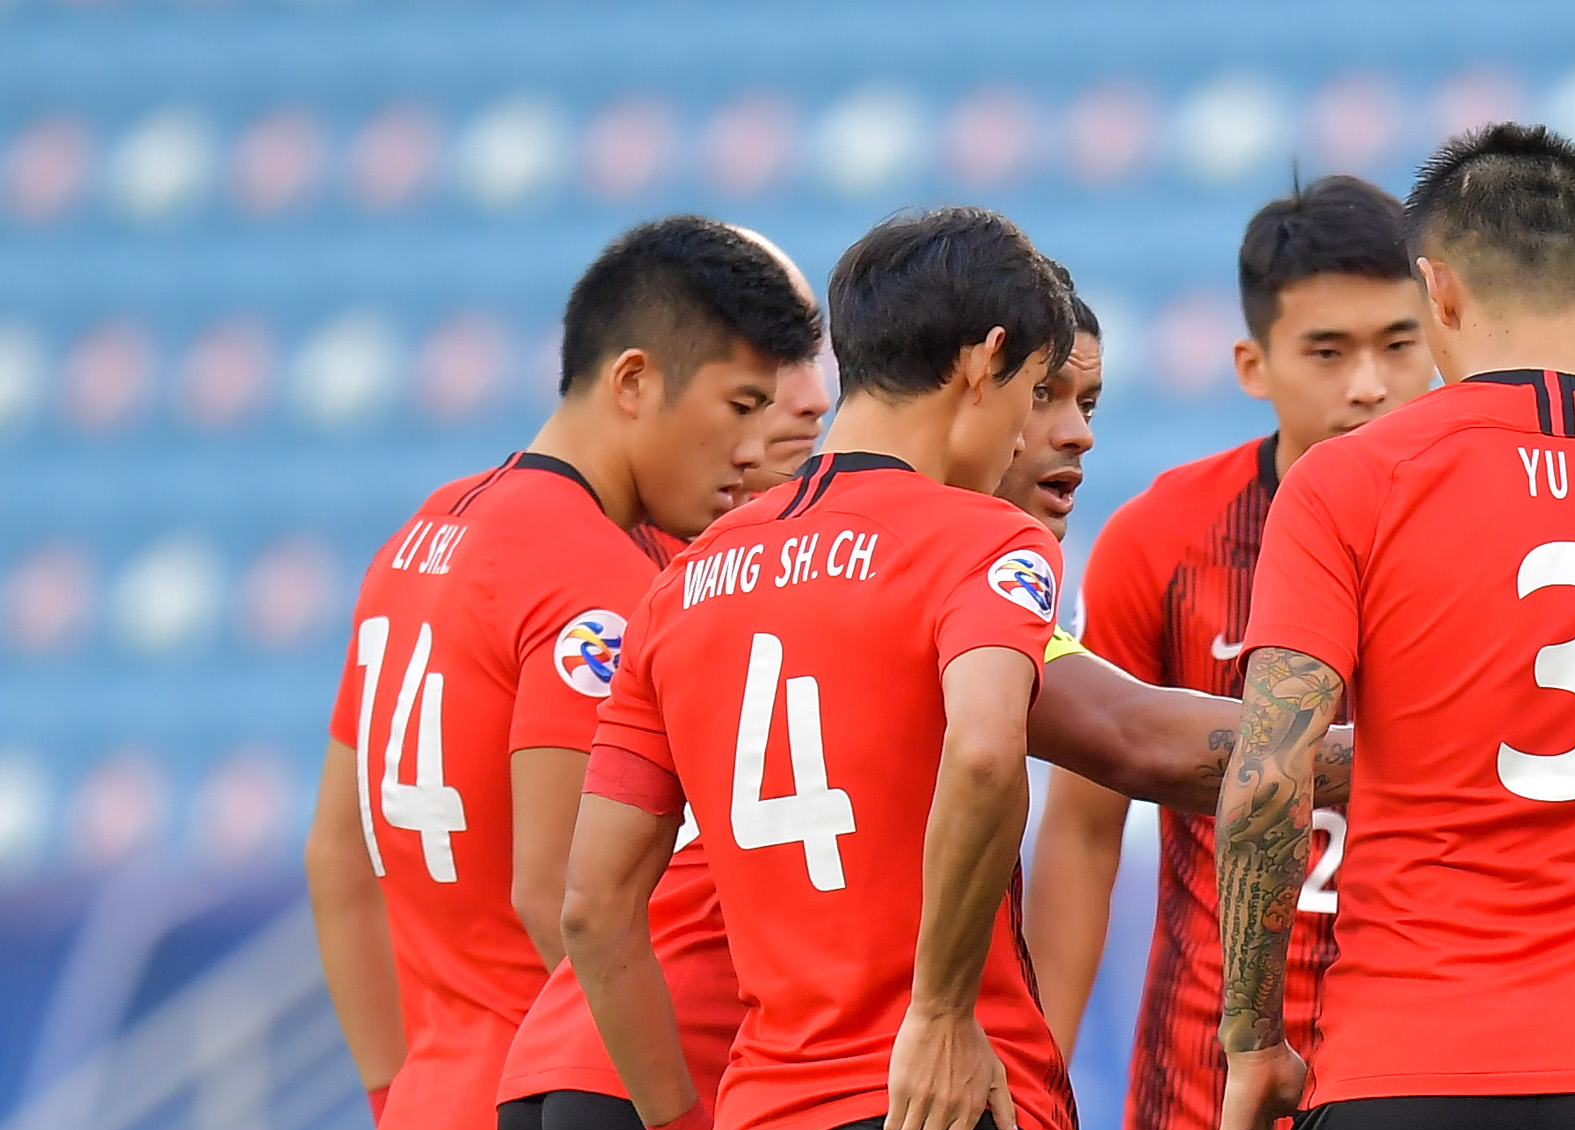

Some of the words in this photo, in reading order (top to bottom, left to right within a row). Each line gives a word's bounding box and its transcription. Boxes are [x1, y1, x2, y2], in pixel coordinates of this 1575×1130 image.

[1517, 446, 1569, 500] YU
[391, 519, 434, 571] LI
[682, 542, 765, 610] WANG
[356, 615, 468, 884] 14
[731, 632, 857, 893] 4
